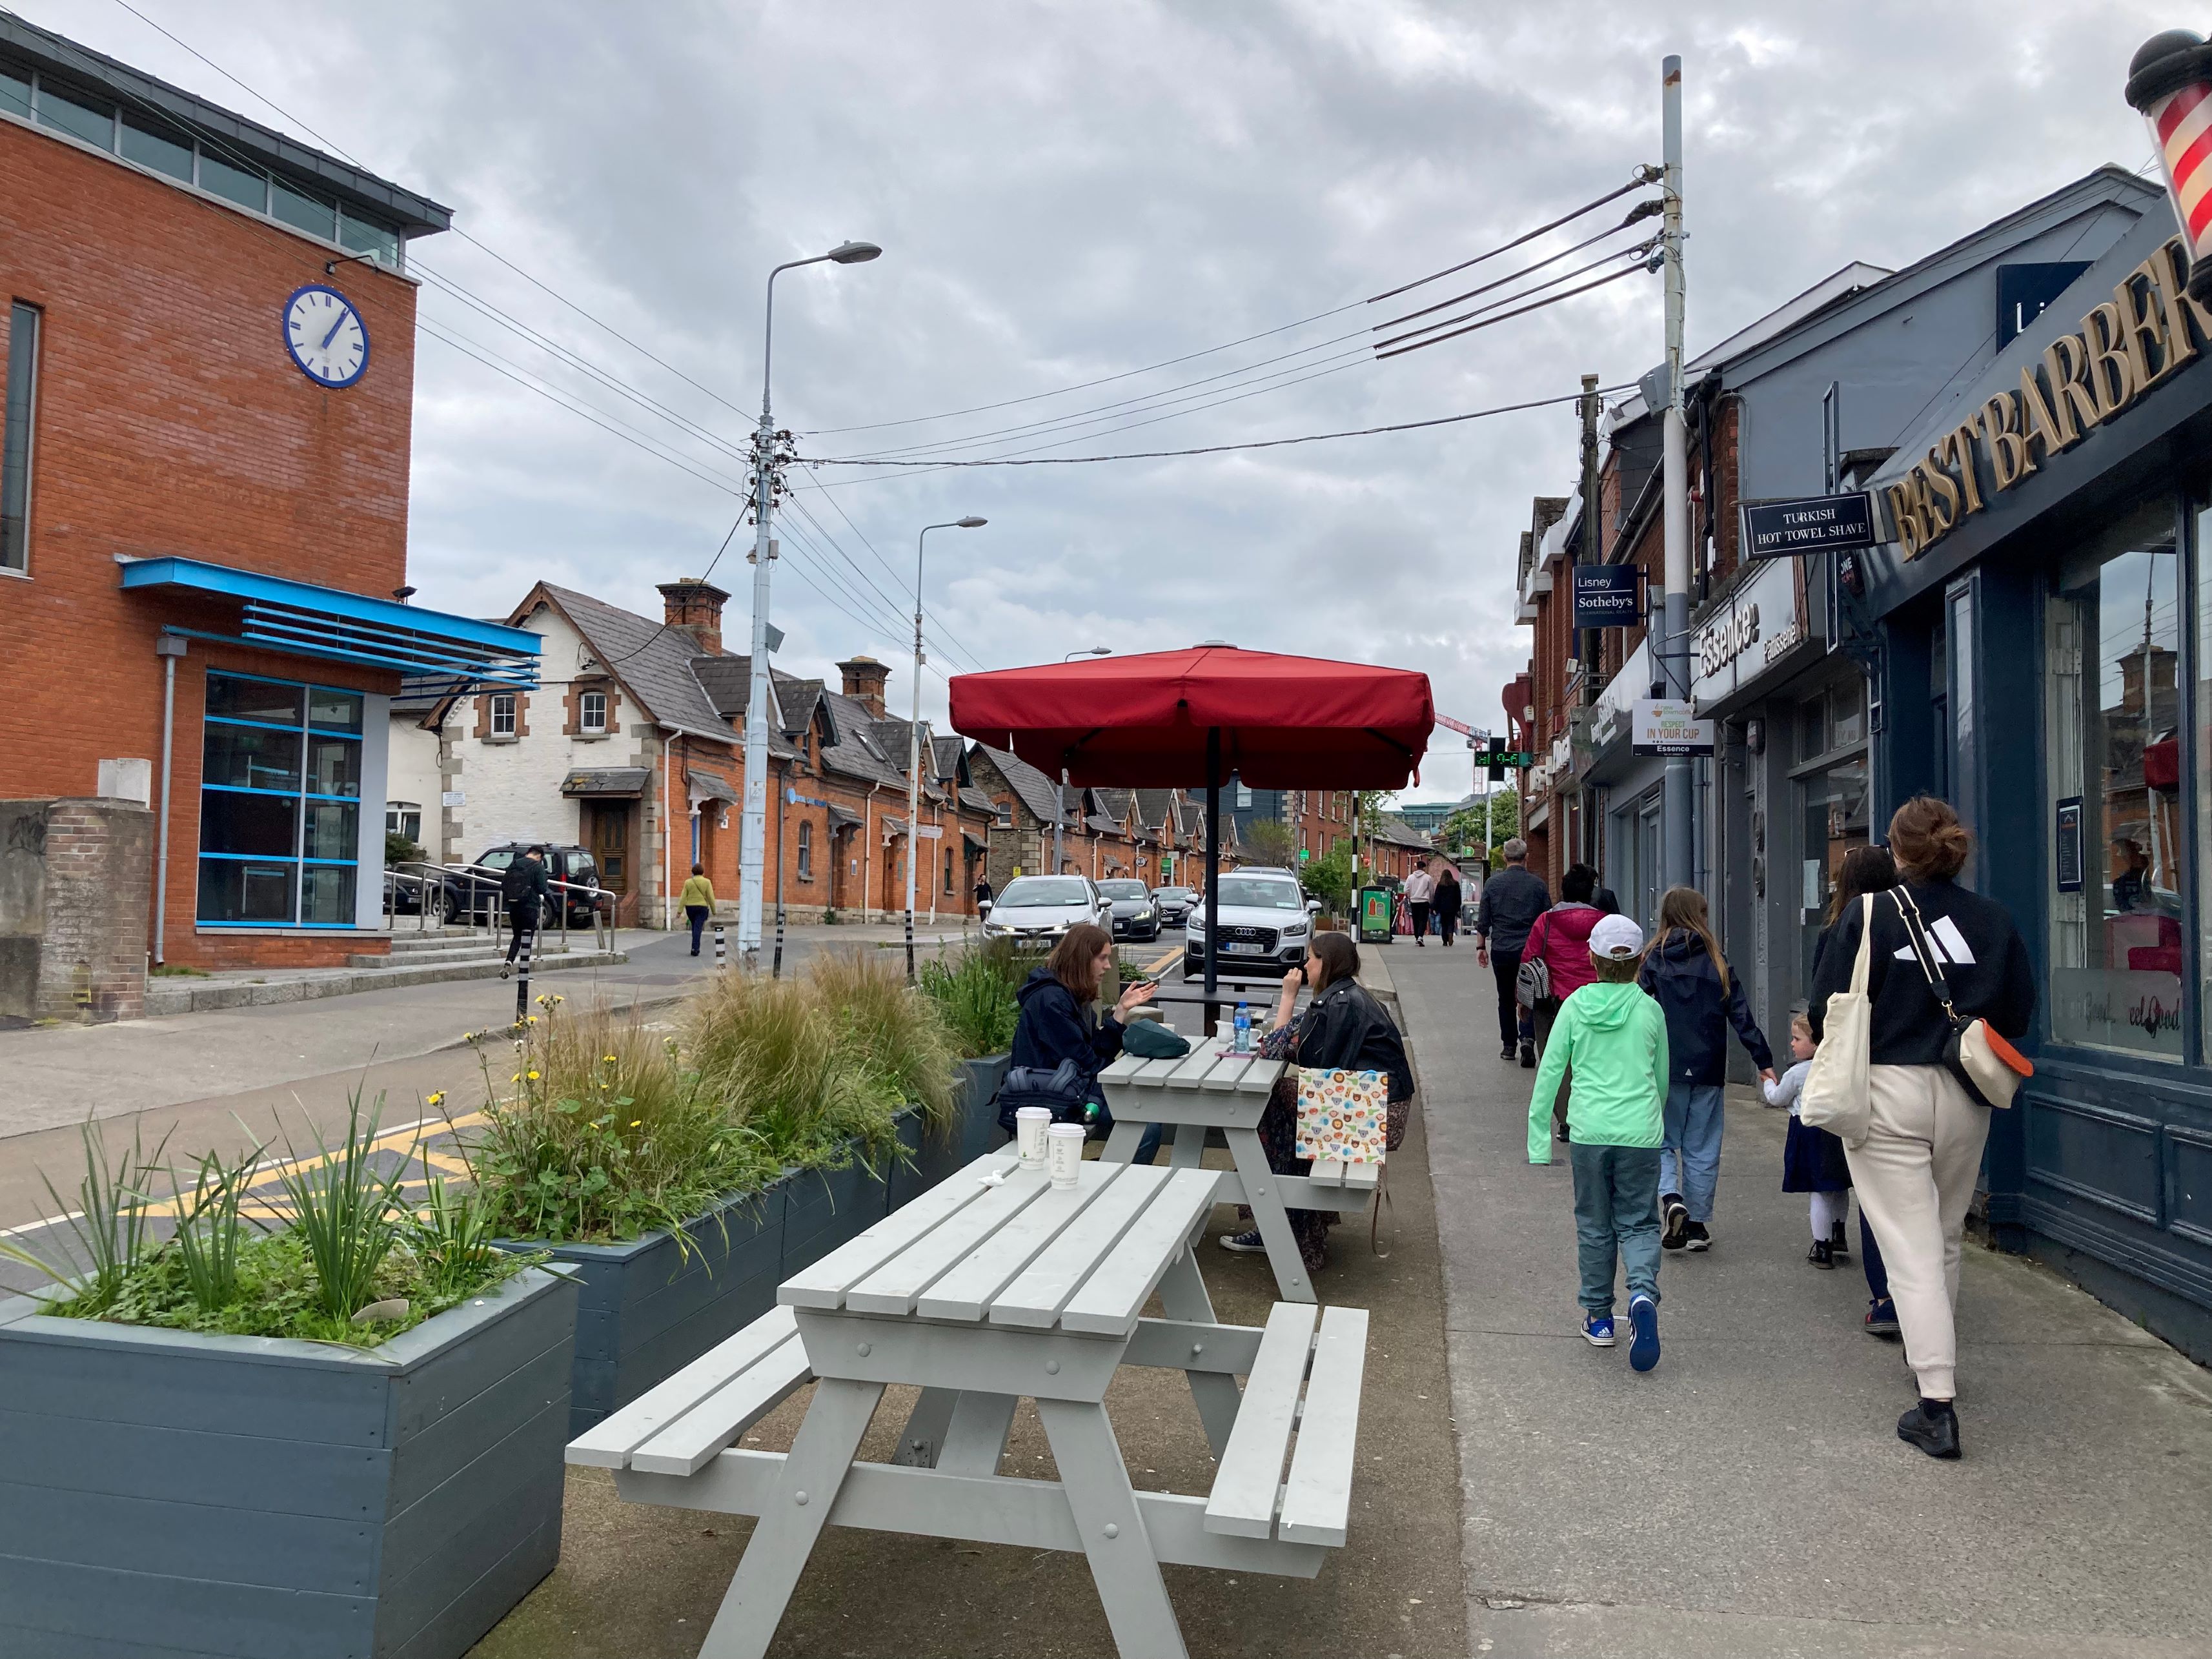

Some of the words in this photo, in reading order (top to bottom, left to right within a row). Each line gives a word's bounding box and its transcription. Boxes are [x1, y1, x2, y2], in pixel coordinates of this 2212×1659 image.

[1888, 413, 1983, 563] BEST
[1783, 509, 1836, 524] TURKISH
[1758, 532, 1781, 544] HOT
[1785, 527, 1825, 541] TOWEL
[1829, 523, 1866, 536] SHAVE
[1578, 577, 1612, 588] Lisney
[1579, 596, 1633, 608] Sotheby's
[1700, 604, 1756, 679] Essence
[1690, 695, 1696, 713] 8
[1647, 728, 1656, 738] IN
[1658, 728, 1681, 739] YOUR
[1683, 728, 1700, 739] CUP
